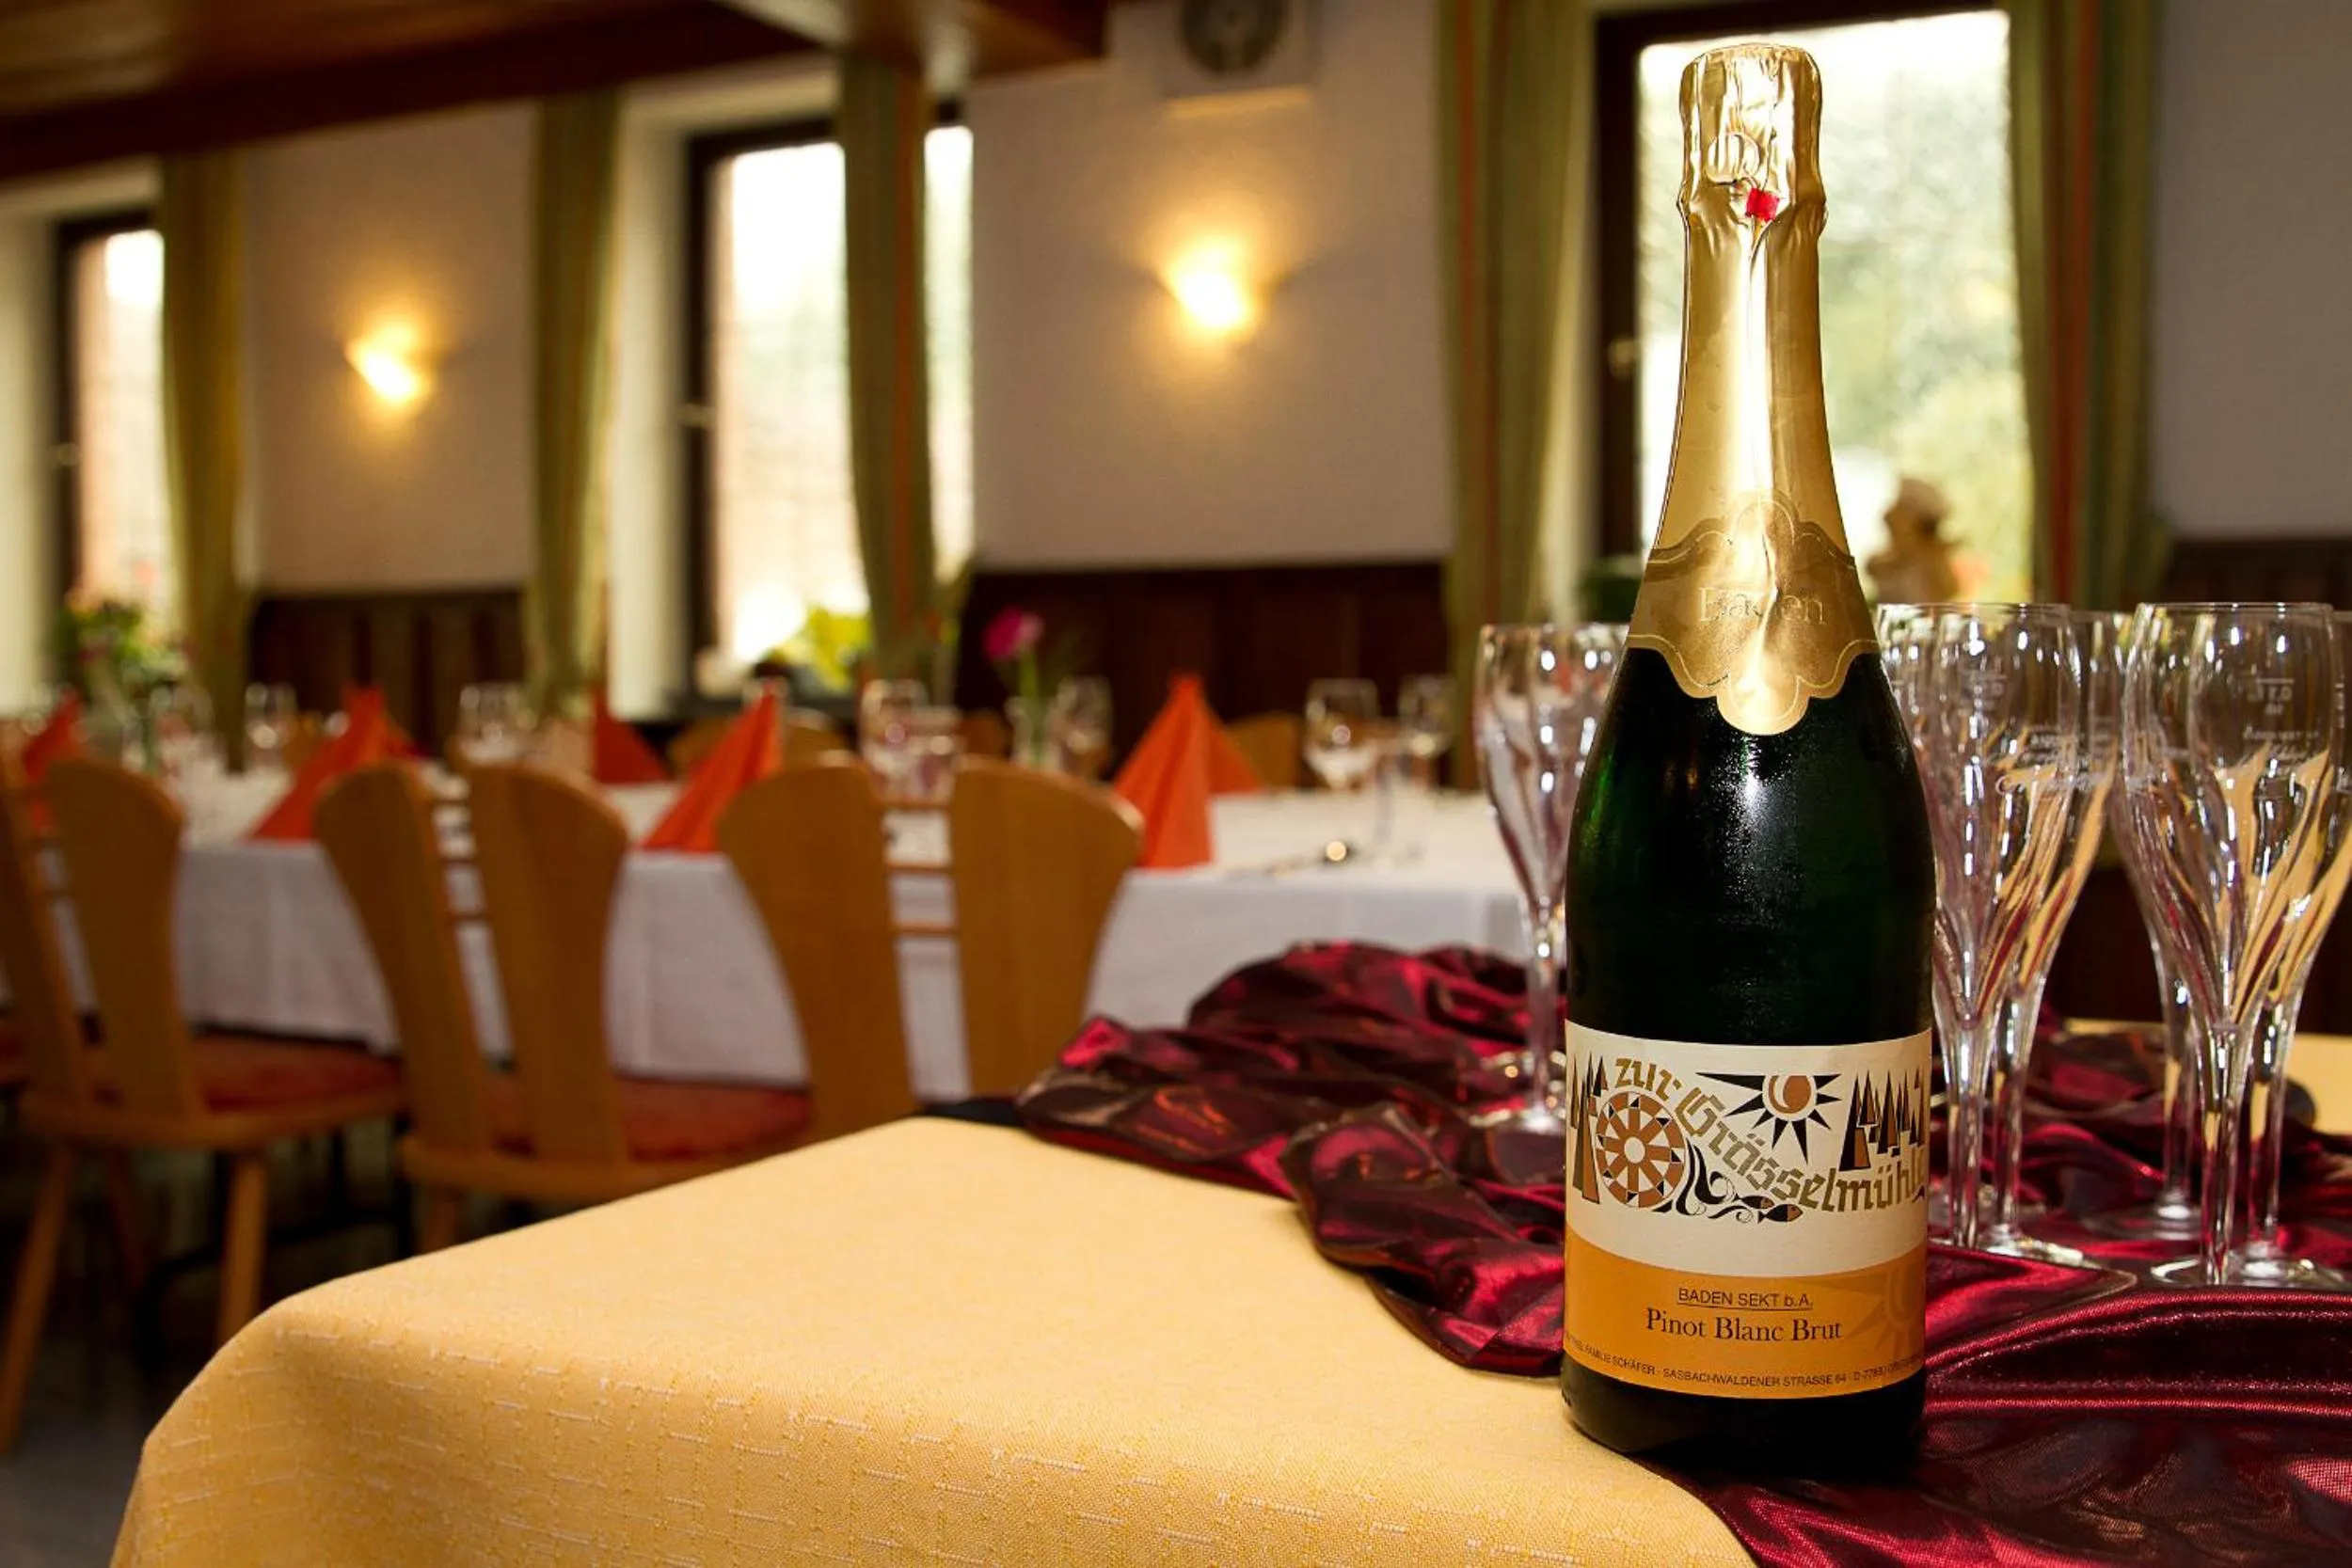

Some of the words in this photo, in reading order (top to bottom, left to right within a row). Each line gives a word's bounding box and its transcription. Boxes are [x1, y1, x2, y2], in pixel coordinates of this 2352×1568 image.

[1613, 1057, 1682, 1101] zur
[1678, 1288, 1733, 1306] BADEN
[1738, 1293, 1779, 1307] SEKT
[1784, 1293, 1814, 1307] b.A.
[1646, 1307, 1707, 1337] Pinot
[1715, 1317, 1784, 1341] Blanc
[1791, 1319, 1842, 1341] Brut
[1663, 1369, 1780, 1387] SASBACHWALDENER
[1783, 1374, 1834, 1387] STRASSE
